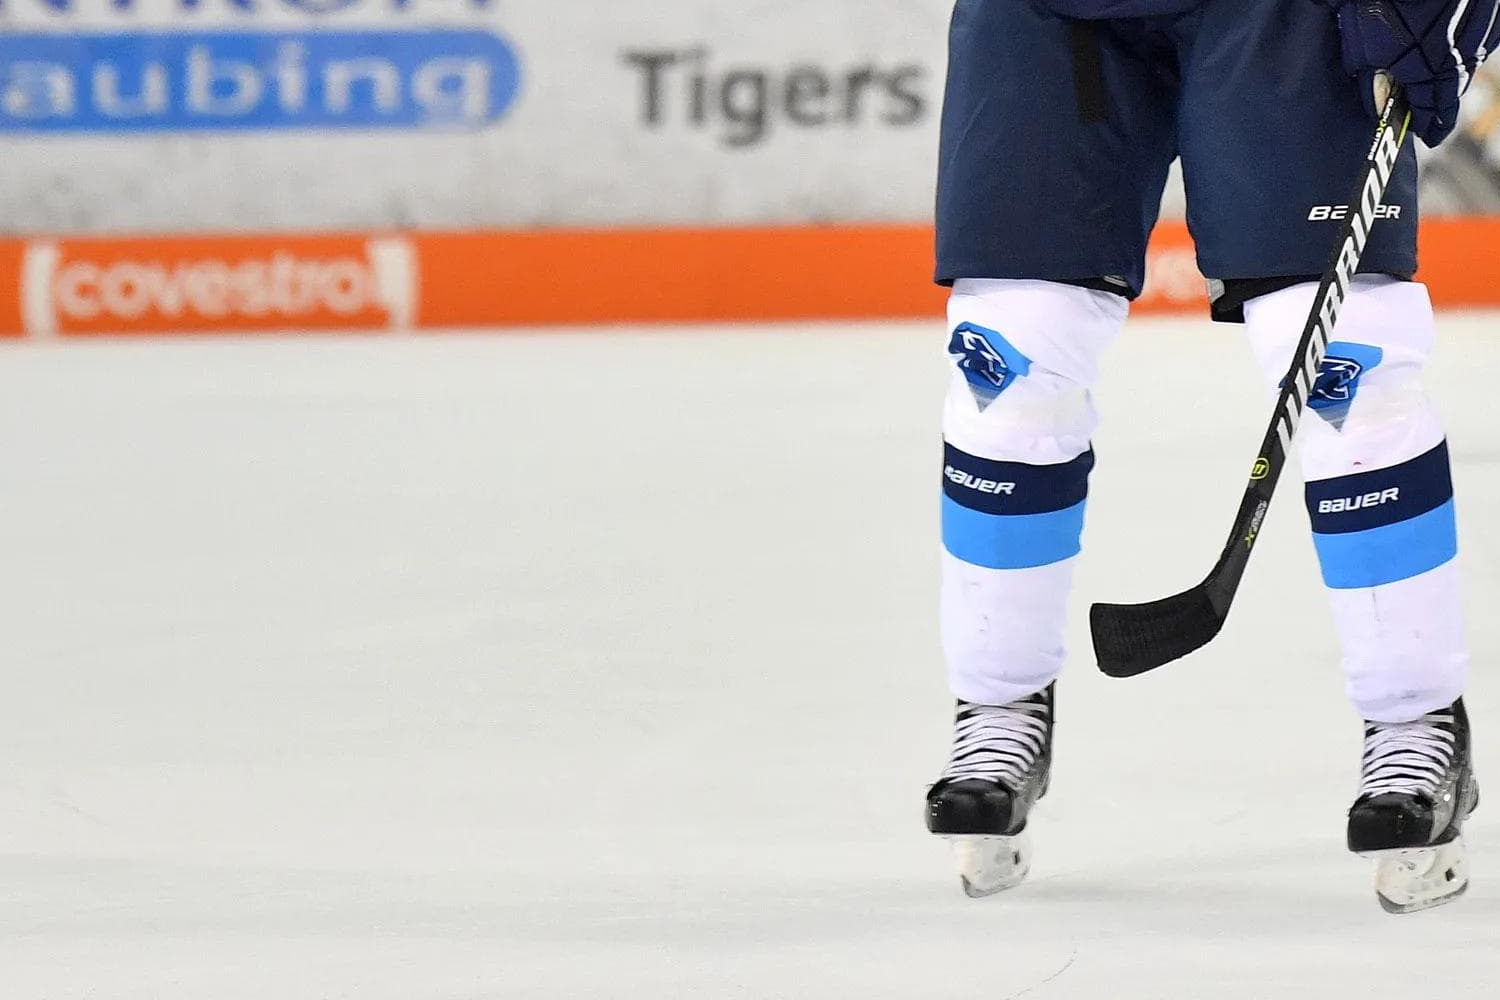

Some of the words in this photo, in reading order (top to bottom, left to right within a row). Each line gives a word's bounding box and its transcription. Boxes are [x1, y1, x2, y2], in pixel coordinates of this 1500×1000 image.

[617, 45, 932, 150] Tigers
[57, 254, 374, 318] covestro
[1275, 124, 1401, 458] WARRIOR
[1318, 486, 1400, 514] BAUER
